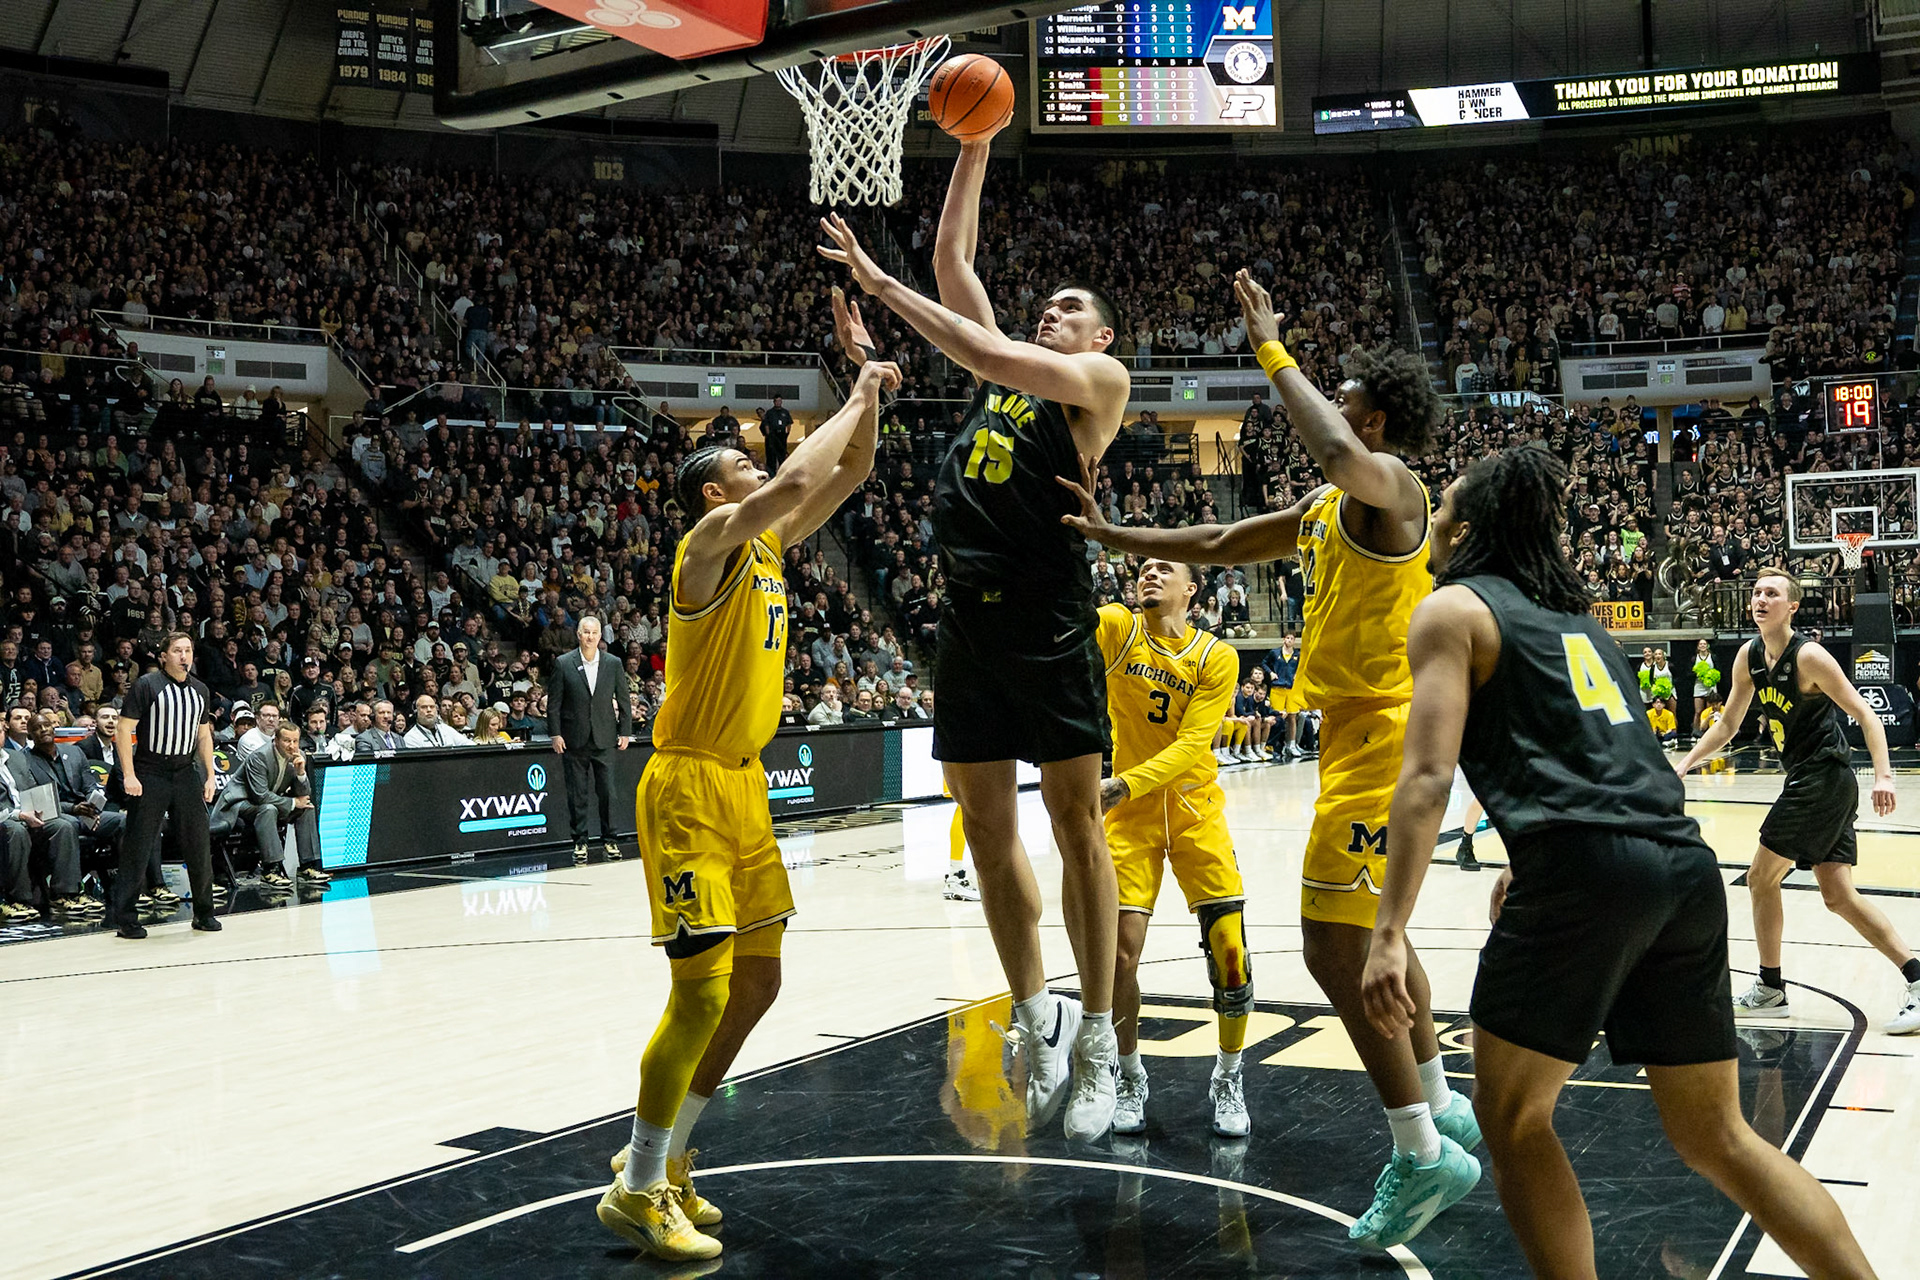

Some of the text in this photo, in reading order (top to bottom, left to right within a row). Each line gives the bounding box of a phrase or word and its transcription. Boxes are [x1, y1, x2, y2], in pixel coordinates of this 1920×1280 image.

[1114, 4, 1191, 13] 10 0 2 0 3
[337, 9, 370, 21] PURDUE
[376, 14, 409, 26] PURDUE
[1047, 14, 1191, 23] 4 Burnett 0 1 3 0 1
[1223, 6, 1256, 30] M
[415, 18, 433, 29] PUR
[1057, 25, 1095, 33] Williams
[1117, 25, 1123, 33] 4
[1152, 25, 1158, 33] 0
[1170, 25, 1174, 33] 1
[1186, 25, 1192, 33] 0
[341, 30, 365, 40] MEN'S
[381, 34, 403, 45] MEN'S
[339, 39, 367, 48] BIG TEN
[378, 43, 406, 53] BIG TEN
[338, 47, 369, 57] CHAMPS
[1058, 46, 1081, 54] Reed
[1117, 46, 1123, 54] 4
[1153, 46, 1158, 54] 1
[1171, 46, 1175, 54] 1
[1187, 46, 1193, 54] 3
[377, 51, 407, 62] CHAMPS
[339, 65, 368, 78] 1979
[379, 68, 407, 83] 1984
[1058, 71, 1084, 79] Loyer
[1137, 71, 1141, 79] 1
[1154, 71, 1159, 79] 1
[1058, 81, 1085, 89] Smith
[1136, 81, 1142, 89] 4
[1554, 61, 1838, 100] THANK YOU FOR YOUR DONATION!
[1049, 92, 1055, 100] 4
[1458, 87, 1502, 100] HAMMER
[1558, 80, 1838, 111] ALL PROCEEDS GO TOWARDS THE PURDUE INSTITUTE FOR CANCER RESEARCH
[1155, 103, 1160, 111] 1
[1173, 103, 1177, 111] 1
[1190, 103, 1195, 111] 1
[1220, 94, 1265, 118] P
[1459, 99, 1486, 109] DWN
[1059, 113, 1087, 121] Jones
[1156, 113, 1160, 121] 1
[1459, 107, 1503, 120] CNCER
[593, 162, 624, 180] 103
[1835, 384, 1872, 401] 18:00
[1846, 401, 1870, 426] 19
[964, 427, 1014, 484] 15
[1592, 605, 1613, 616] IVES
[764, 604, 784, 650] 13
[1601, 617, 1613, 628] RE
[1125, 662, 1196, 697] MICHIGAN
[1561, 632, 1634, 726] 4
[1147, 689, 1171, 724] 3
[1769, 719, 1785, 753] 2
[765, 768, 812, 788] YWAY
[460, 792, 546, 820] XYWAY
[508, 827, 547, 837] FUNGICIDES
[1348, 822, 1387, 855] M
[663, 871, 697, 905] M
